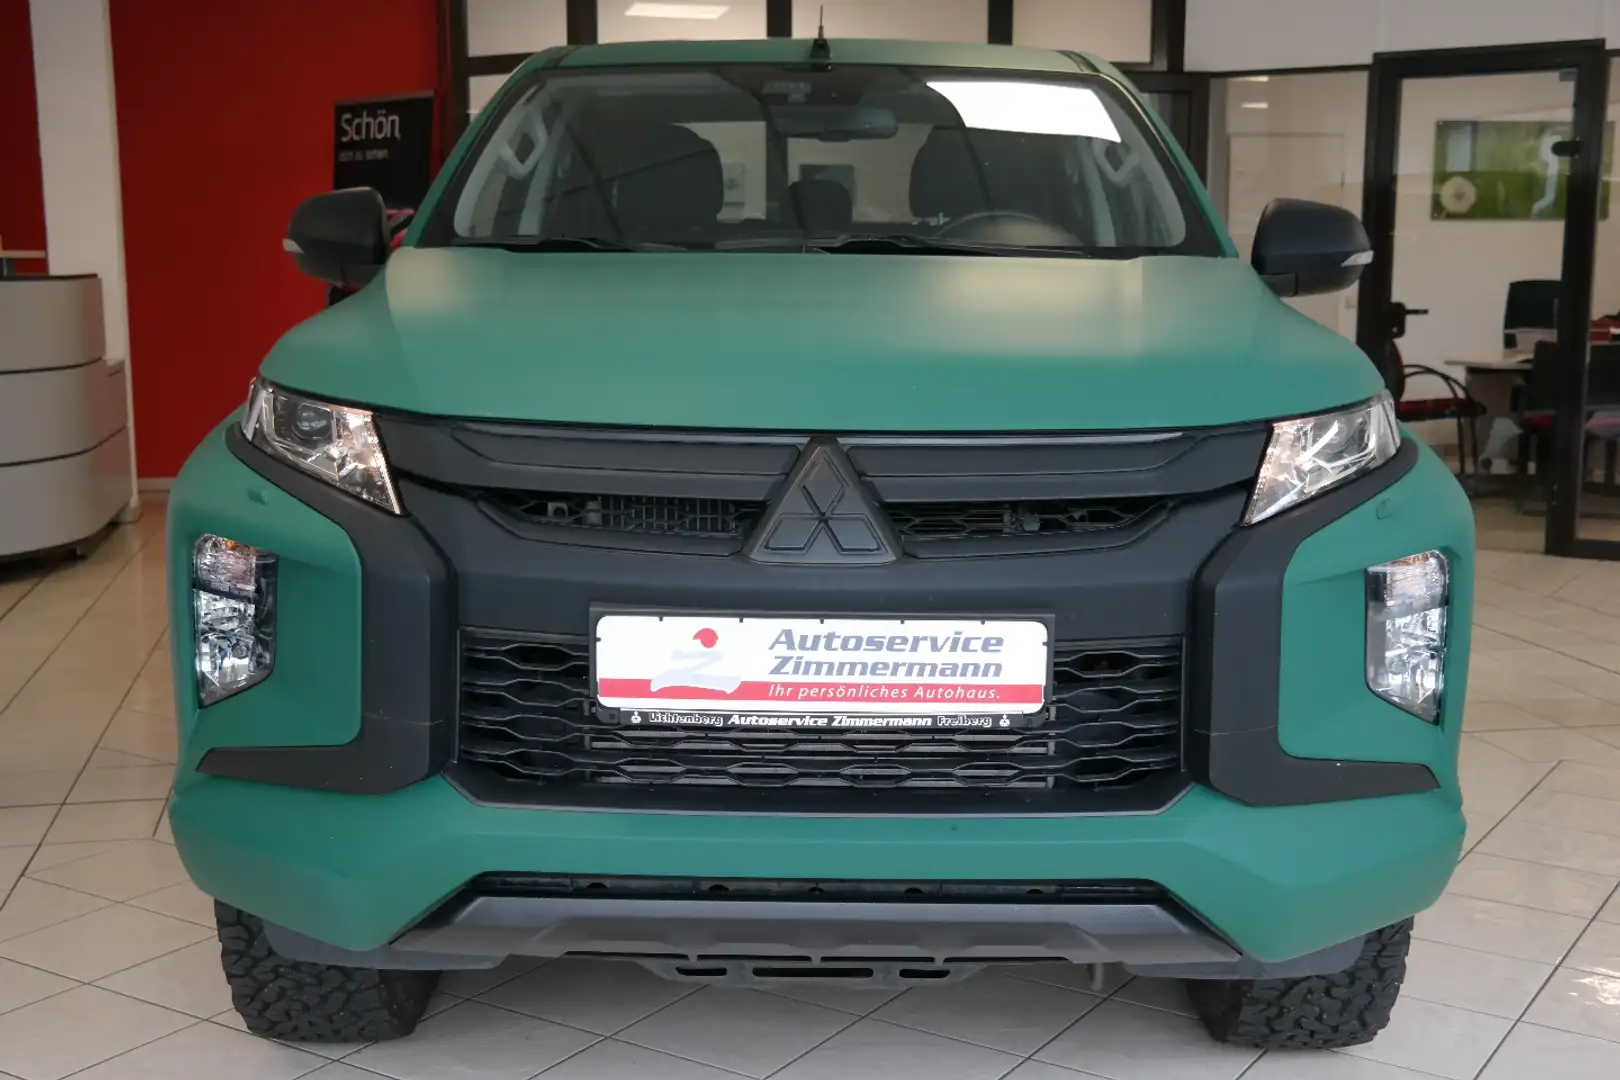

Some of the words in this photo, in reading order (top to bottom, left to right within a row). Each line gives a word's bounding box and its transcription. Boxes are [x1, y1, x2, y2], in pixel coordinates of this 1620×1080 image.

[768, 629, 1004, 653] Autoservice
[768, 656, 1003, 677] Zimmermann
[768, 684, 794, 697] Ihr
[798, 685, 908, 700] persönliches
[913, 686, 1001, 699] Autohaus.
[727, 714, 829, 727] Autoservice
[831, 715, 932, 728] Zimmermann
[937, 716, 992, 728] Freiberg
